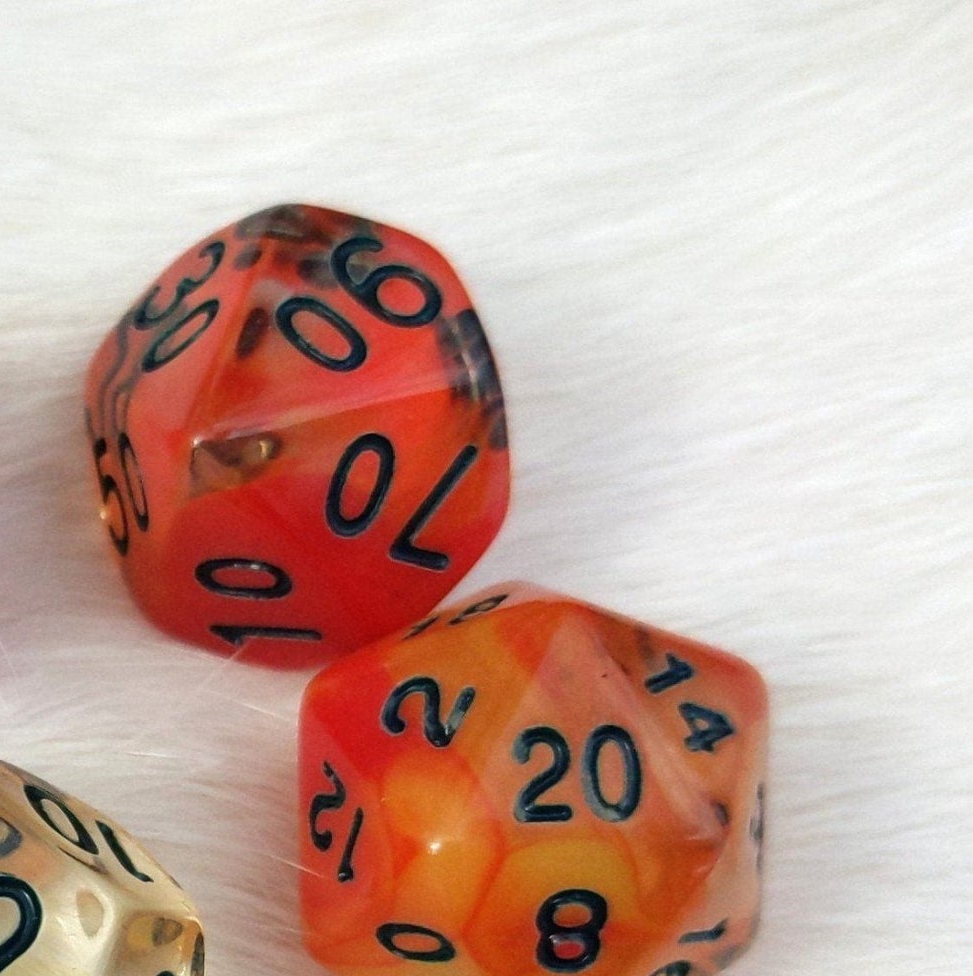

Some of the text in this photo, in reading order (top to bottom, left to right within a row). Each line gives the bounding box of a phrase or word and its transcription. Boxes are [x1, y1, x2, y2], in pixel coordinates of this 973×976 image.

[133, 241, 226, 372] 30
[93, 432, 149, 556] 50
[326, 432, 479, 572] 70
[194, 557, 323, 647] 10
[380, 675, 476, 748] 2
[645, 652, 736, 753] 14
[309, 761, 364, 883] 12
[513, 724, 644, 824] 20
[23, 784, 154, 884] 10
[535, 887, 609, 974] 8
